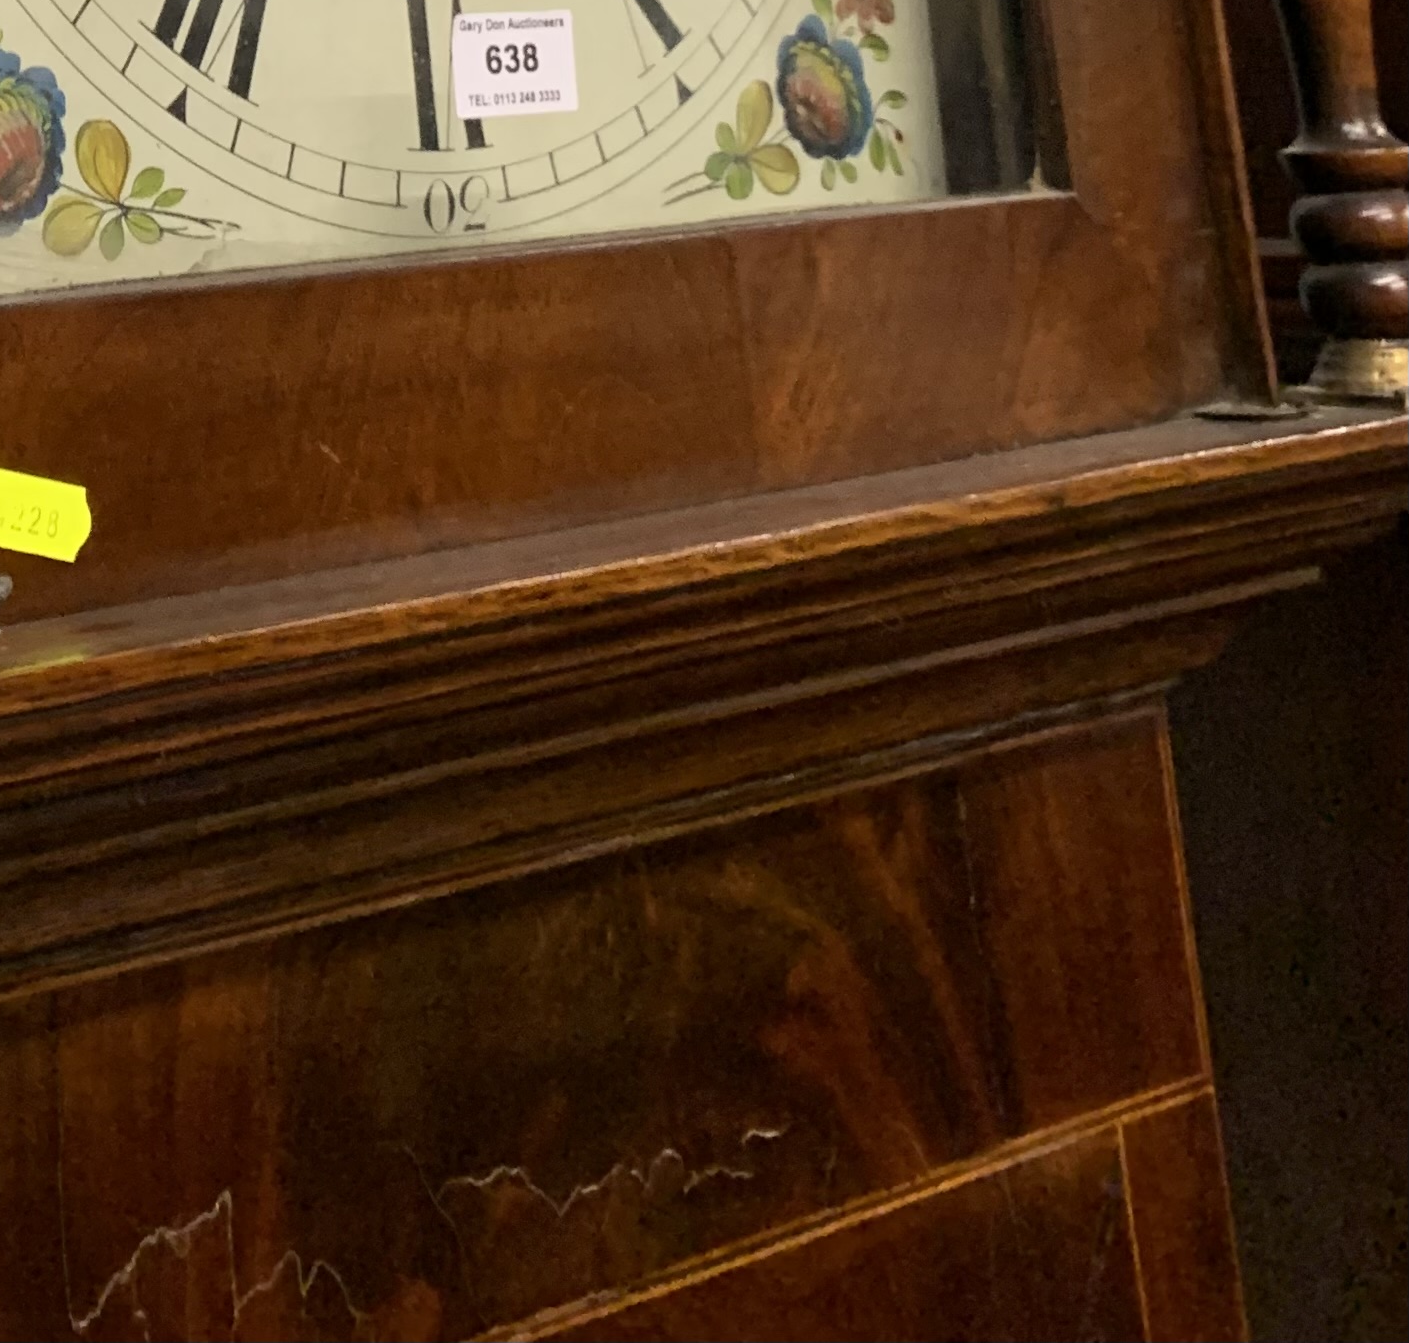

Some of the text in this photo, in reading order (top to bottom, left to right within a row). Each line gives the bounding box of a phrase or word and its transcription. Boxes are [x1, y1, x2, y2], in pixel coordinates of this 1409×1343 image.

[459, 17, 564, 34] Gary Don Auctioneers
[485, 42, 539, 74] 638
[468, 93, 491, 106] TEL:
[493, 92, 516, 105] 0113
